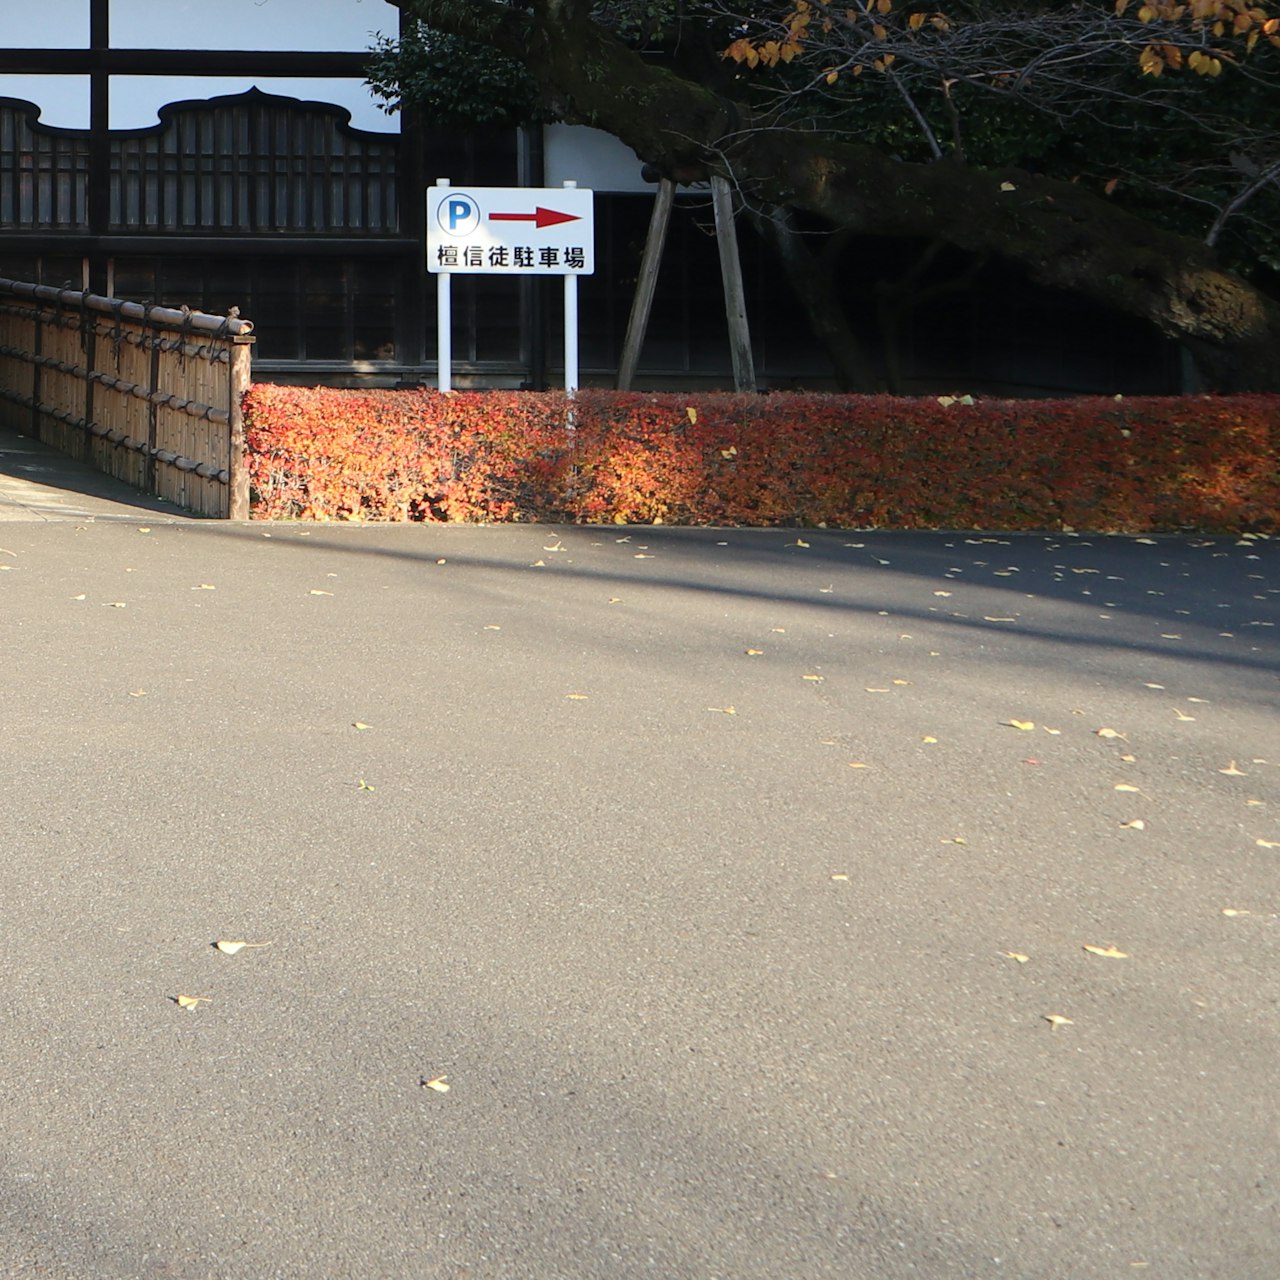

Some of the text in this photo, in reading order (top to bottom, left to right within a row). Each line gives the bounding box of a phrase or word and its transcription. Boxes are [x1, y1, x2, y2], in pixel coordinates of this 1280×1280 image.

[448, 200, 472, 230] P
[437, 245, 585, 268] 檀信徒駐車場
